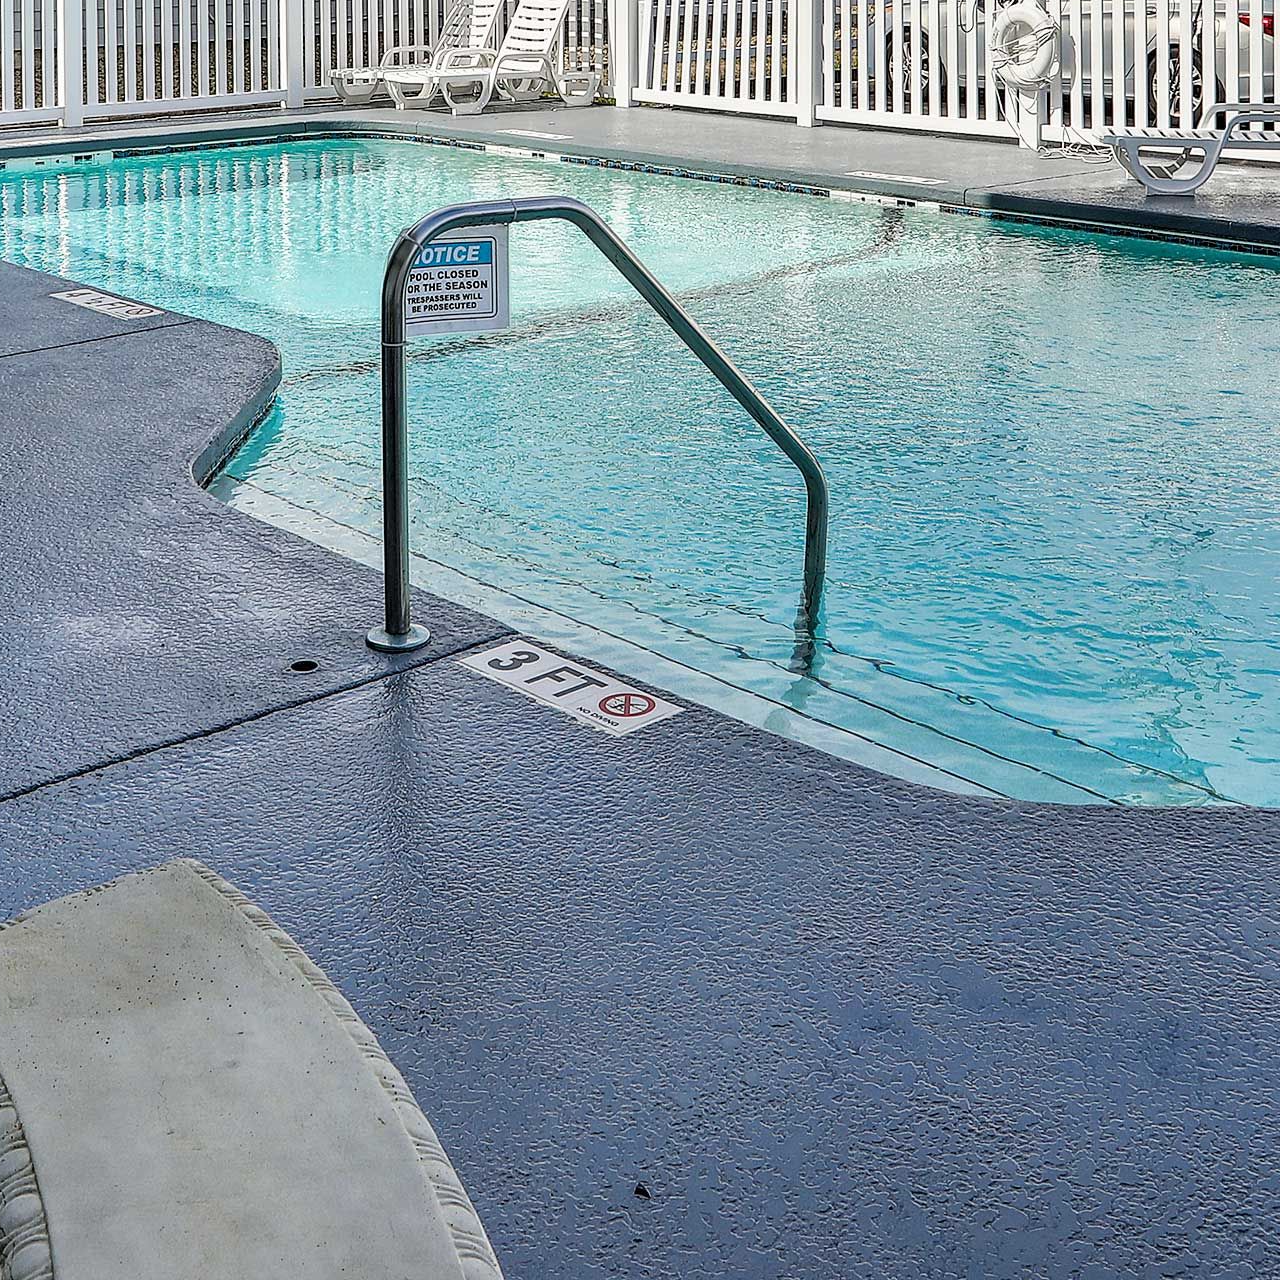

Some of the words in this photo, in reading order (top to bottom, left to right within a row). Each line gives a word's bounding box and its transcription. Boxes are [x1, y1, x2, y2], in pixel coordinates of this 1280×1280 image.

[409, 271, 435, 282] POOL
[437, 269, 479, 279] CLOSED
[407, 284, 421, 293] OR
[423, 283, 442, 292] THE
[445, 280, 488, 290] SEASON
[407, 294, 461, 305] TRESPASSERS
[412, 305, 421, 313] BE
[423, 302, 477, 312] PROSECUTED
[487, 650, 540, 671] 3
[523, 666, 609, 698] FT
